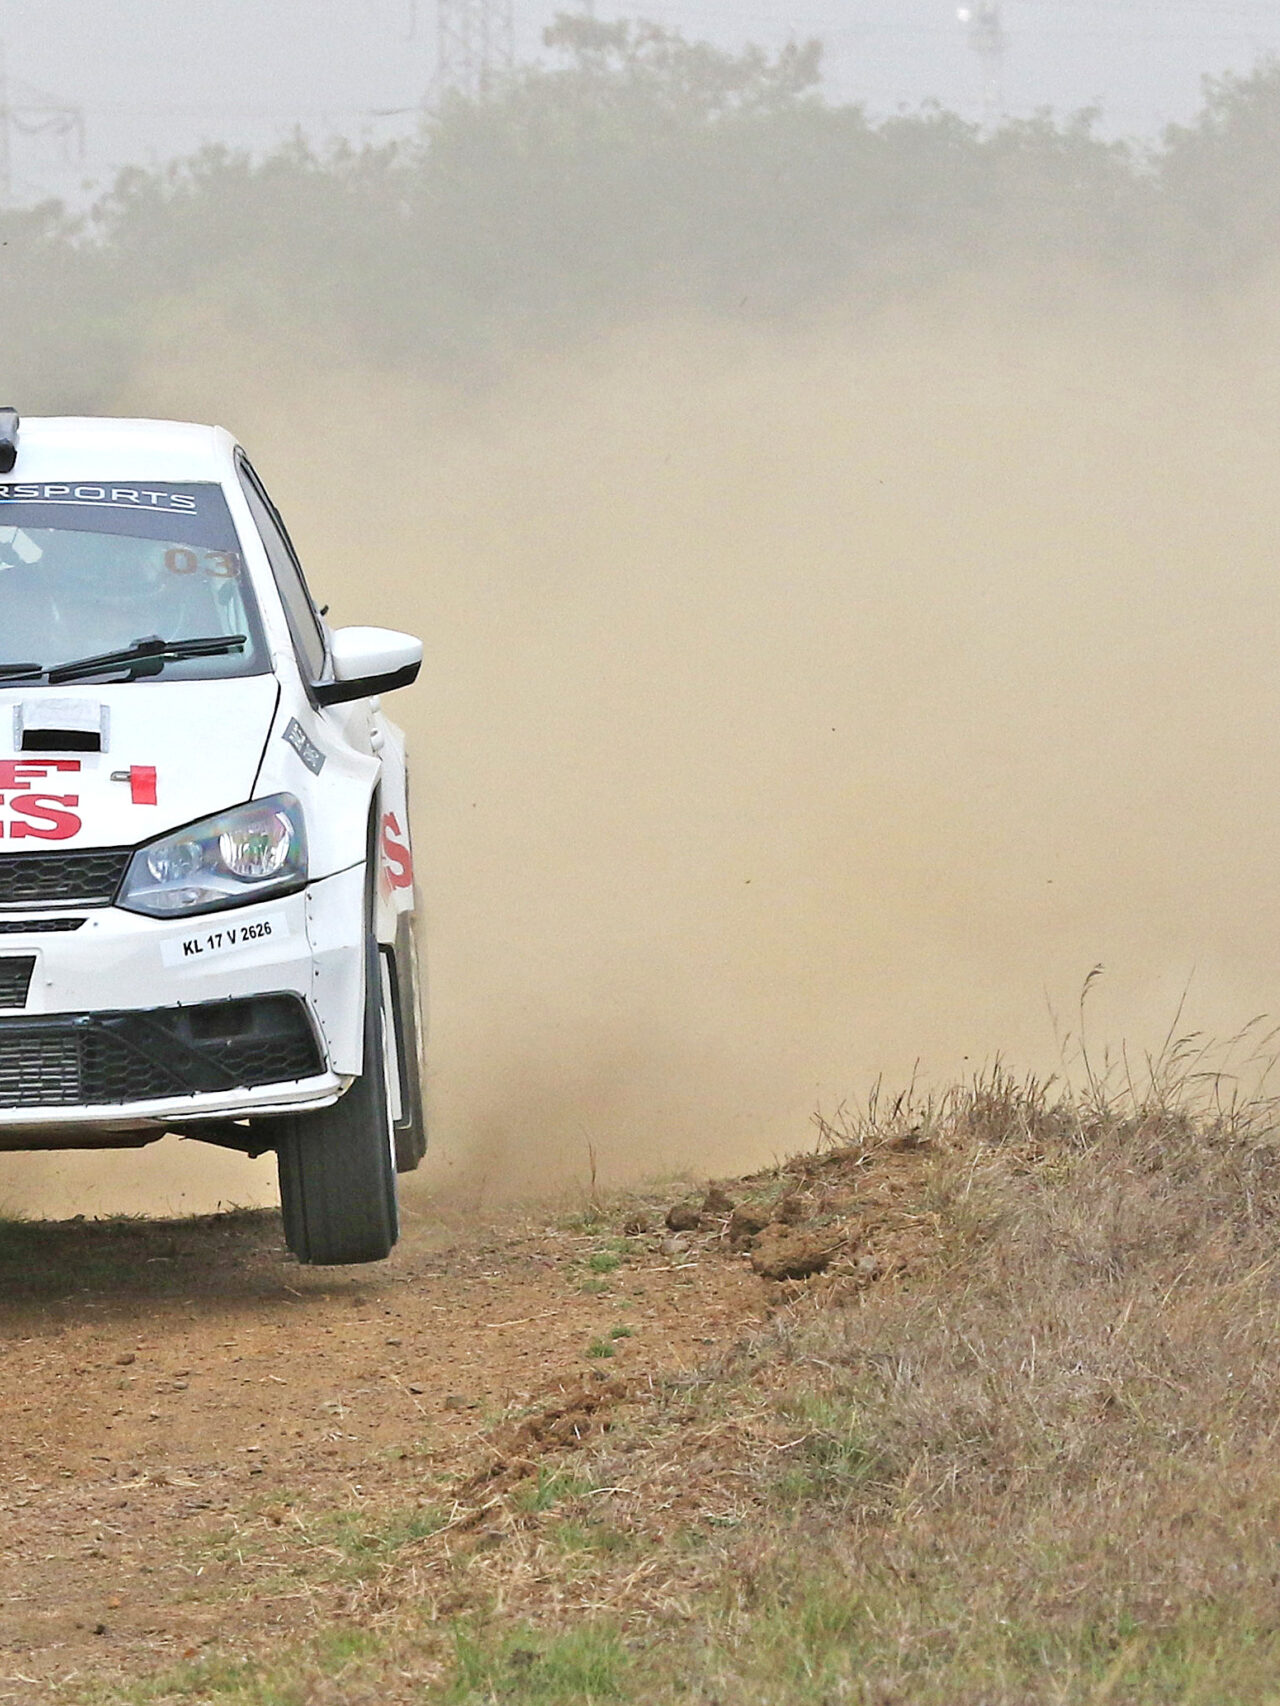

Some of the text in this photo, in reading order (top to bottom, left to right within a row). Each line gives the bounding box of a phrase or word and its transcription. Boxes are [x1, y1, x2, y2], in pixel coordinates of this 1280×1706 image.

[164, 548, 241, 579] 03
[182, 921, 273, 956] KL 17 V 2626
